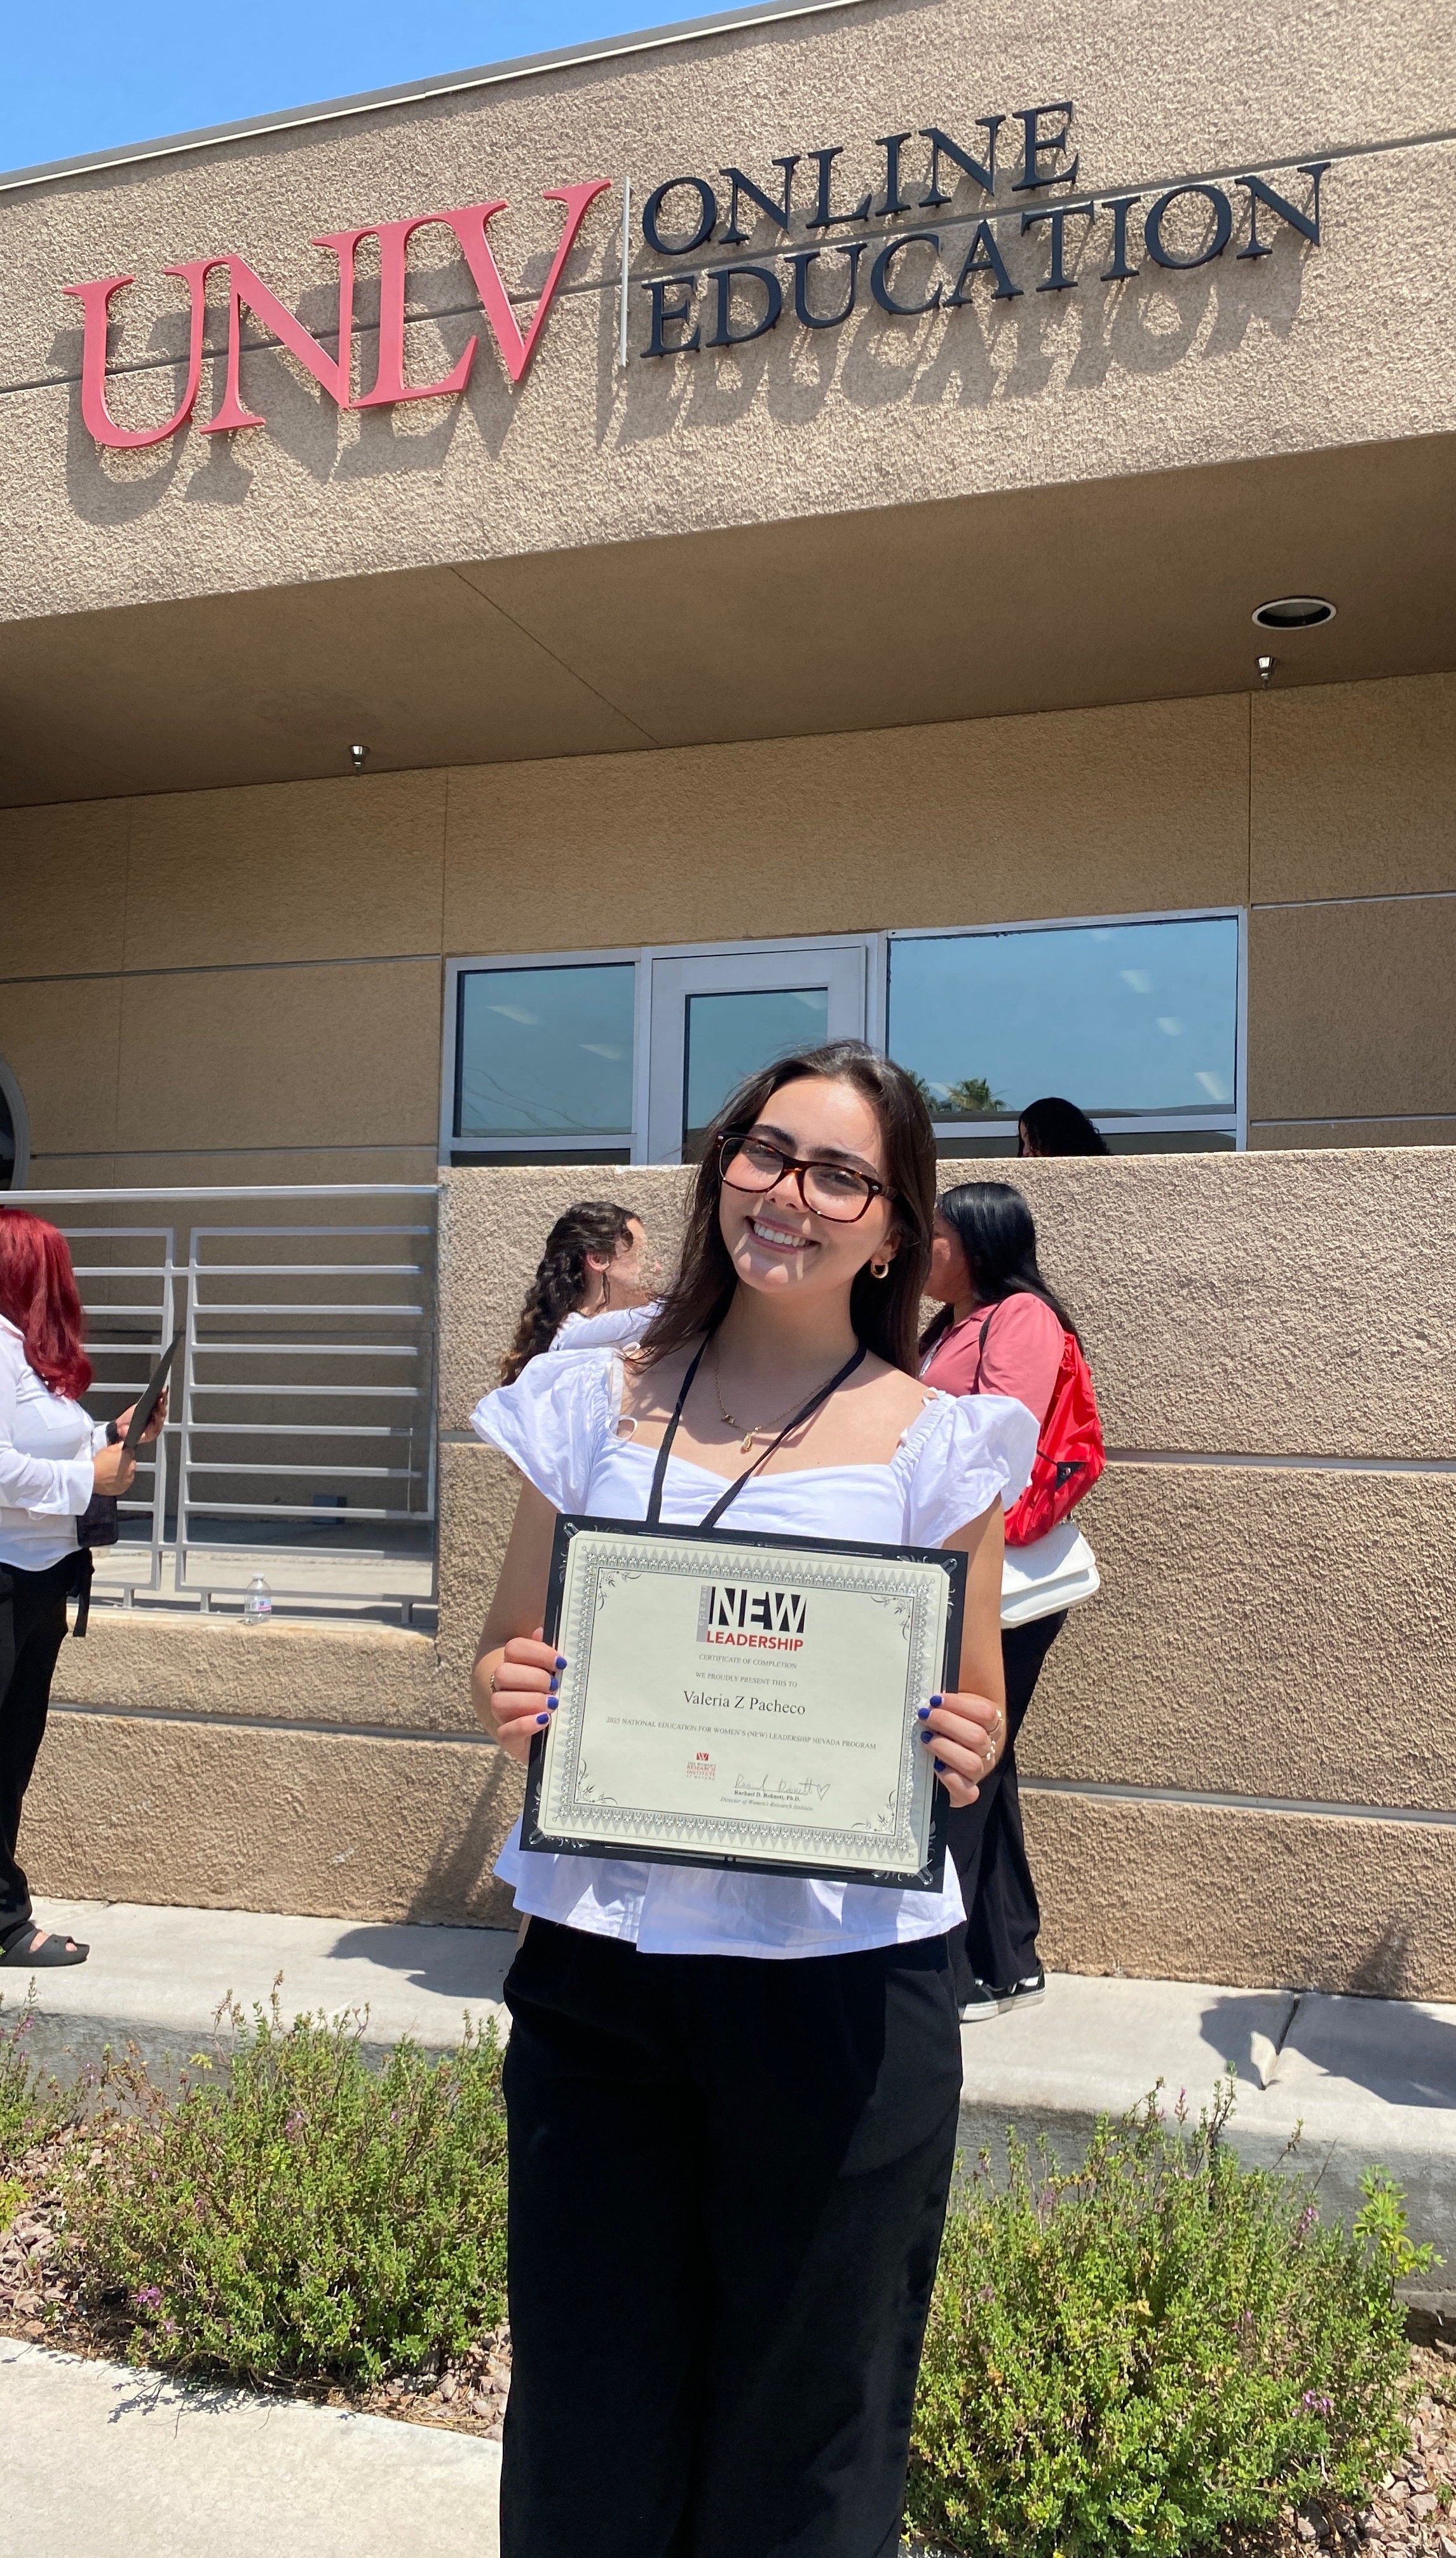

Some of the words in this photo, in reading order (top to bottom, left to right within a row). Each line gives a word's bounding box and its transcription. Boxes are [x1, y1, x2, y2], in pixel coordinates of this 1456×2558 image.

[643, 100, 1078, 254] ONLINE
[640, 161, 1331, 358] EDUCATION
[62, 179, 611, 448] UNLV
[709, 1586, 807, 1634] NEW
[706, 1631, 803, 1651] LEADERSHIP
[699, 1653, 741, 1664] CERTIFICATE
[752, 1659, 797, 1669] COMPLETION
[707, 1674, 739, 1682] PROUDLY
[740, 1676, 770, 1685] PRESENT
[683, 1690, 730, 1707] Valeria
[734, 1695, 745, 1709] Z
[749, 1697, 805, 1714] Pacheco
[622, 1718, 657, 1727] NATIONAL
[658, 1721, 697, 1731] EDUCATION
[713, 1727, 745, 1736] WOMEN'S
[747, 1730, 768, 1739] (NEW)
[769, 1733, 811, 1742] LEADERSHIP
[812, 1737, 840, 1746] NEVADA
[841, 1741, 876, 1749] PROGRAM
